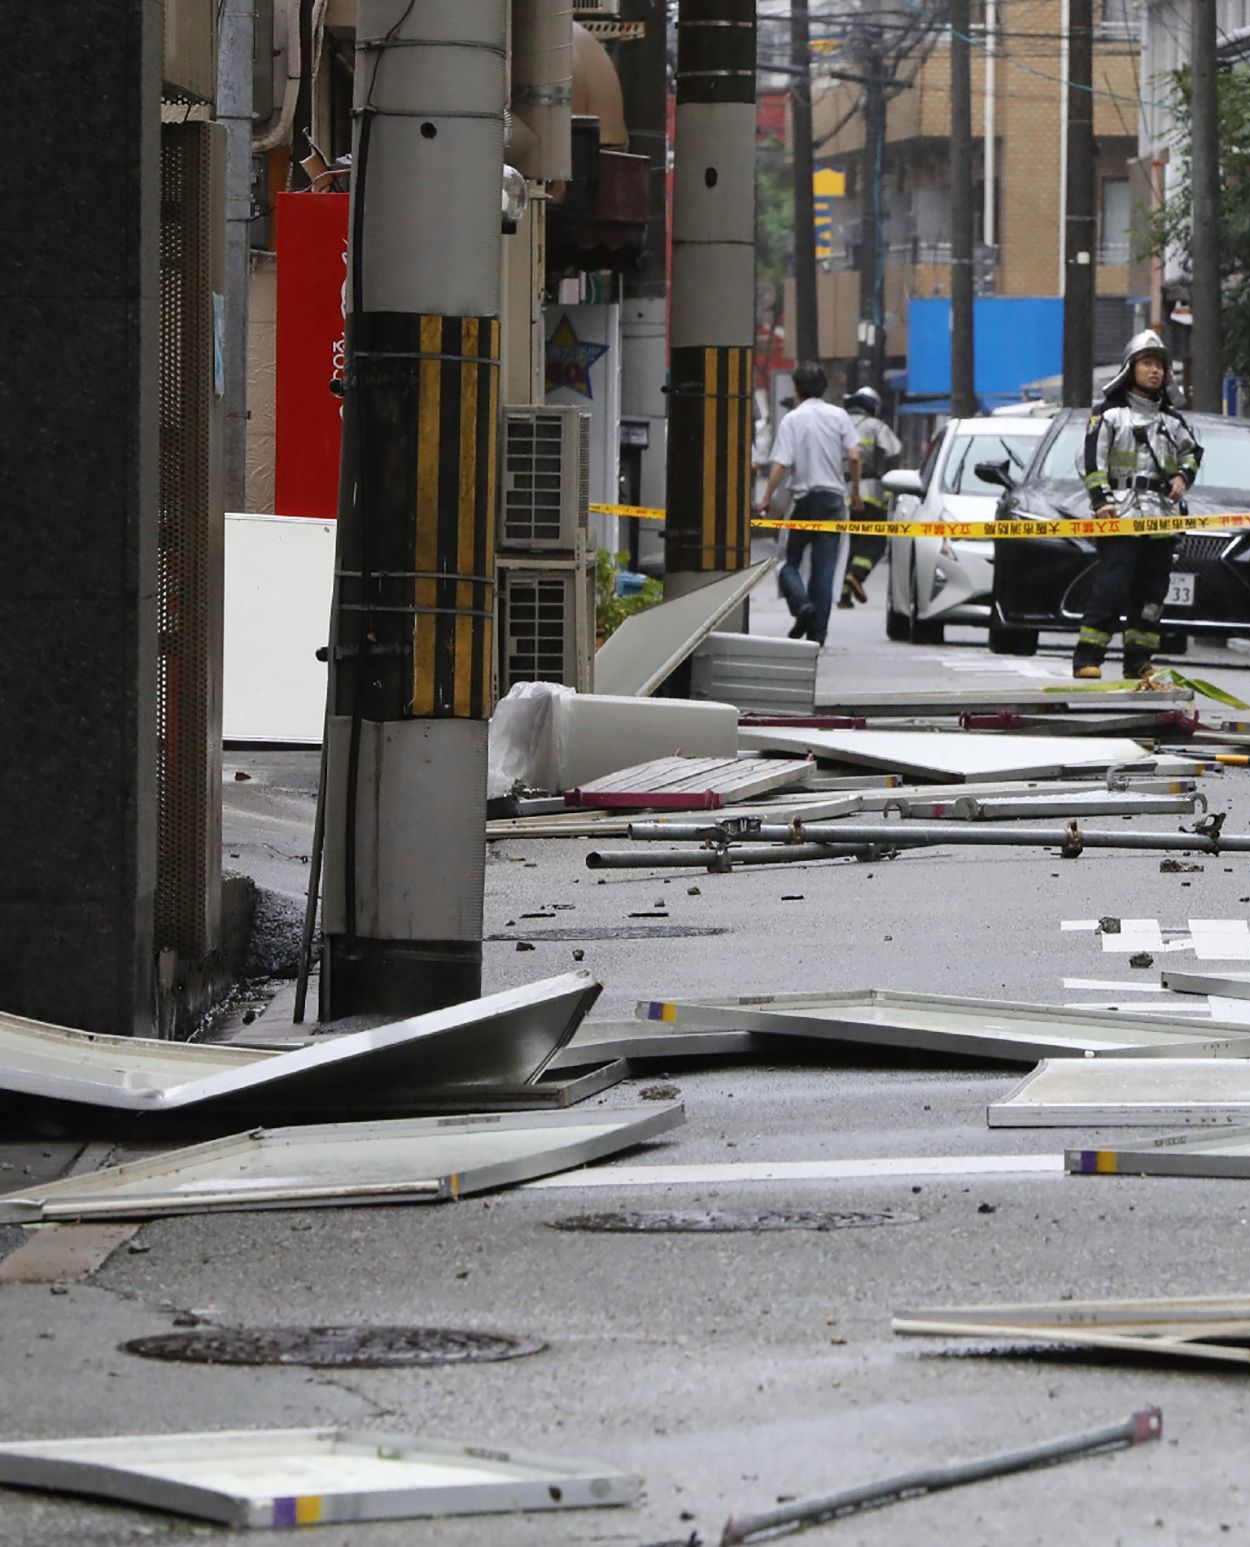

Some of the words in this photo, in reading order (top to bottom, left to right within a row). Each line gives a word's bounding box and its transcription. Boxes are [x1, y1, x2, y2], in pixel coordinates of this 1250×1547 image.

[921, 523, 971, 536] 立入禁止
[984, 522, 1060, 535] 大阪市消防局
[1070, 520, 1120, 533] 立入禁止
[1132, 517, 1209, 532] 大阪市消防局
